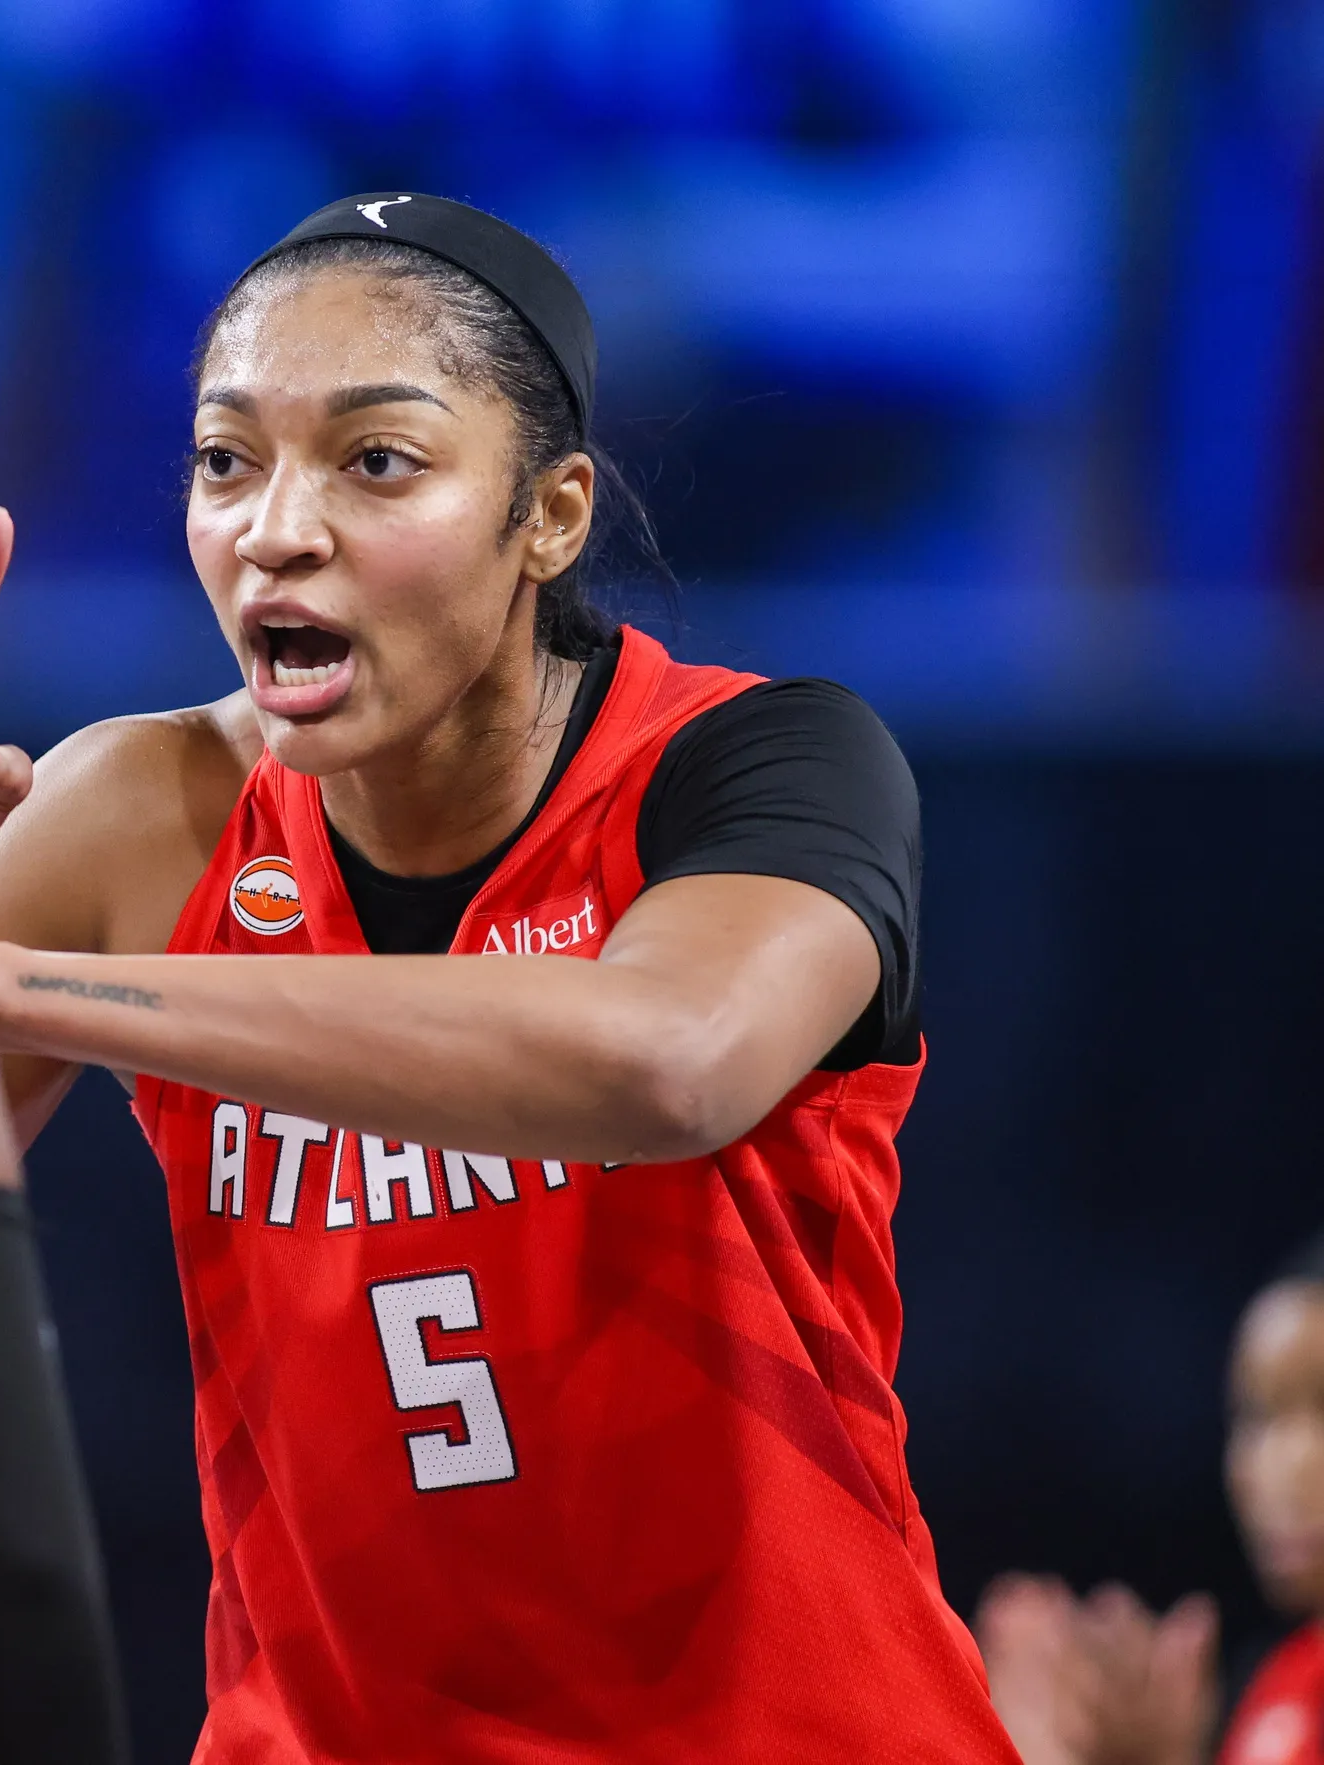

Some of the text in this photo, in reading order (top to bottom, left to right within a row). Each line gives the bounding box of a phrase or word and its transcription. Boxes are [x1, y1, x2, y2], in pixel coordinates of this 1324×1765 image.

[482, 896, 596, 955] Albert
[208, 1100, 631, 1232] ATLAN
[368, 1268, 518, 1492] 5
